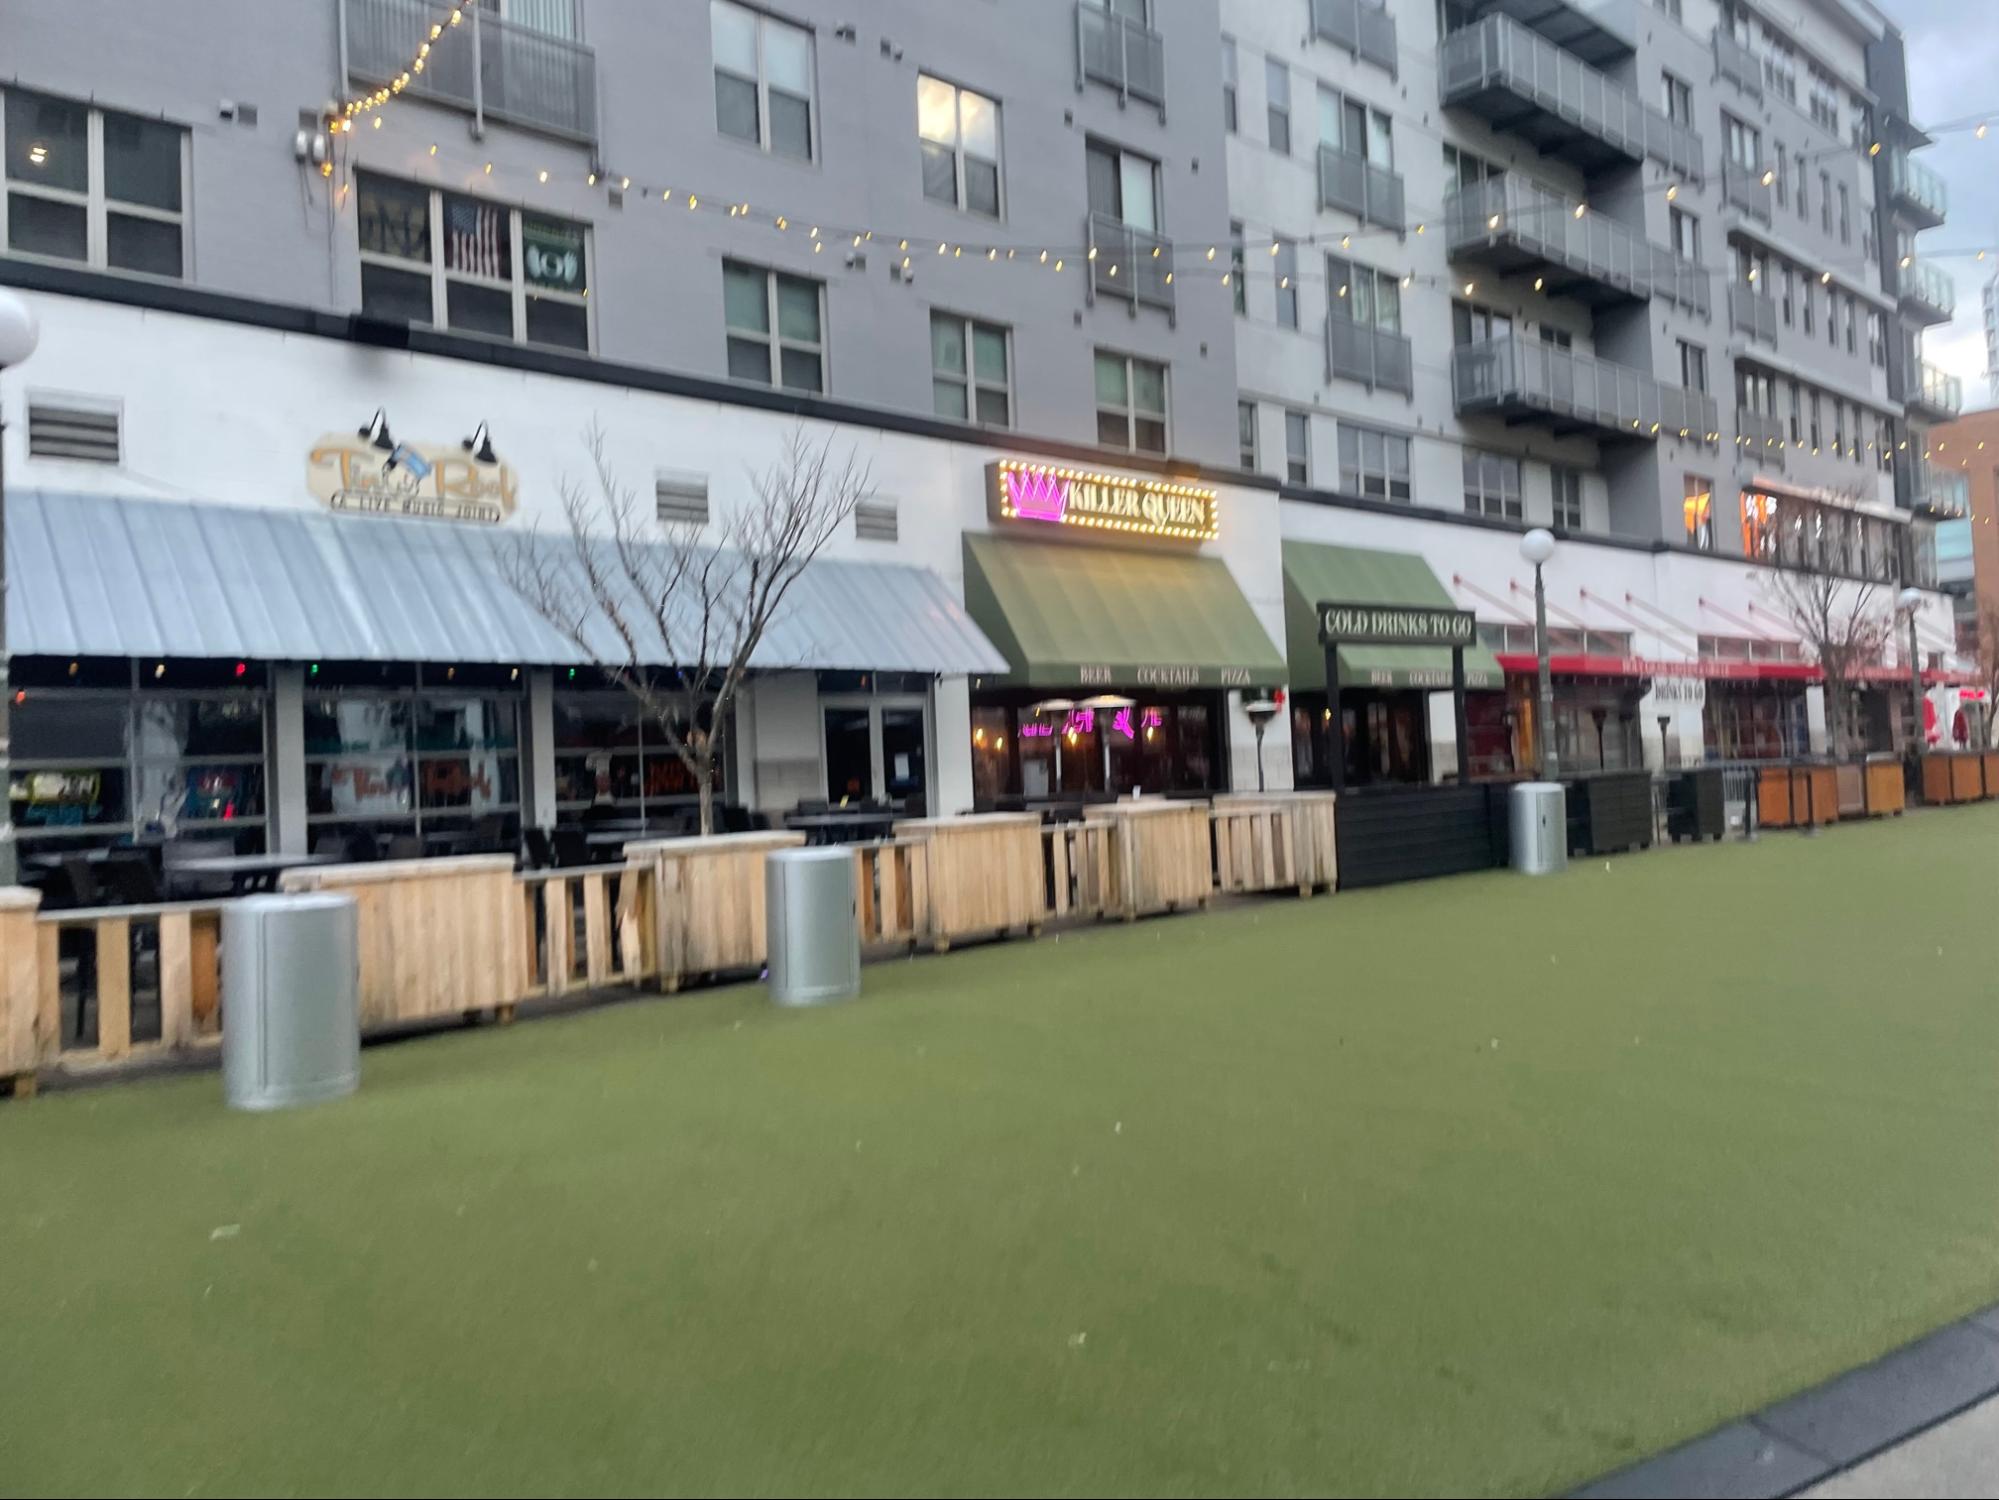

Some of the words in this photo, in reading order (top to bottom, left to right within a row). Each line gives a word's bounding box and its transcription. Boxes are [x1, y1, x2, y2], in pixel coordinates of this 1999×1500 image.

[360, 497, 390, 512] LIVE
[402, 499, 444, 516] MUSIC
[456, 505, 495, 521] JOINT
[1068, 481, 1141, 517] KILLER
[1142, 491, 1205, 528] QUEEN
[1325, 608, 1369, 635] COLD
[1371, 611, 1428, 637] DRINKS
[1430, 614, 1449, 637] TO
[1452, 615, 1472, 638] GO
[1080, 664, 1112, 685] BEER
[1137, 664, 1199, 685] COCKTAILS
[1221, 665, 1251, 685] PIZZA
[1655, 683, 1683, 701] DRINKS
